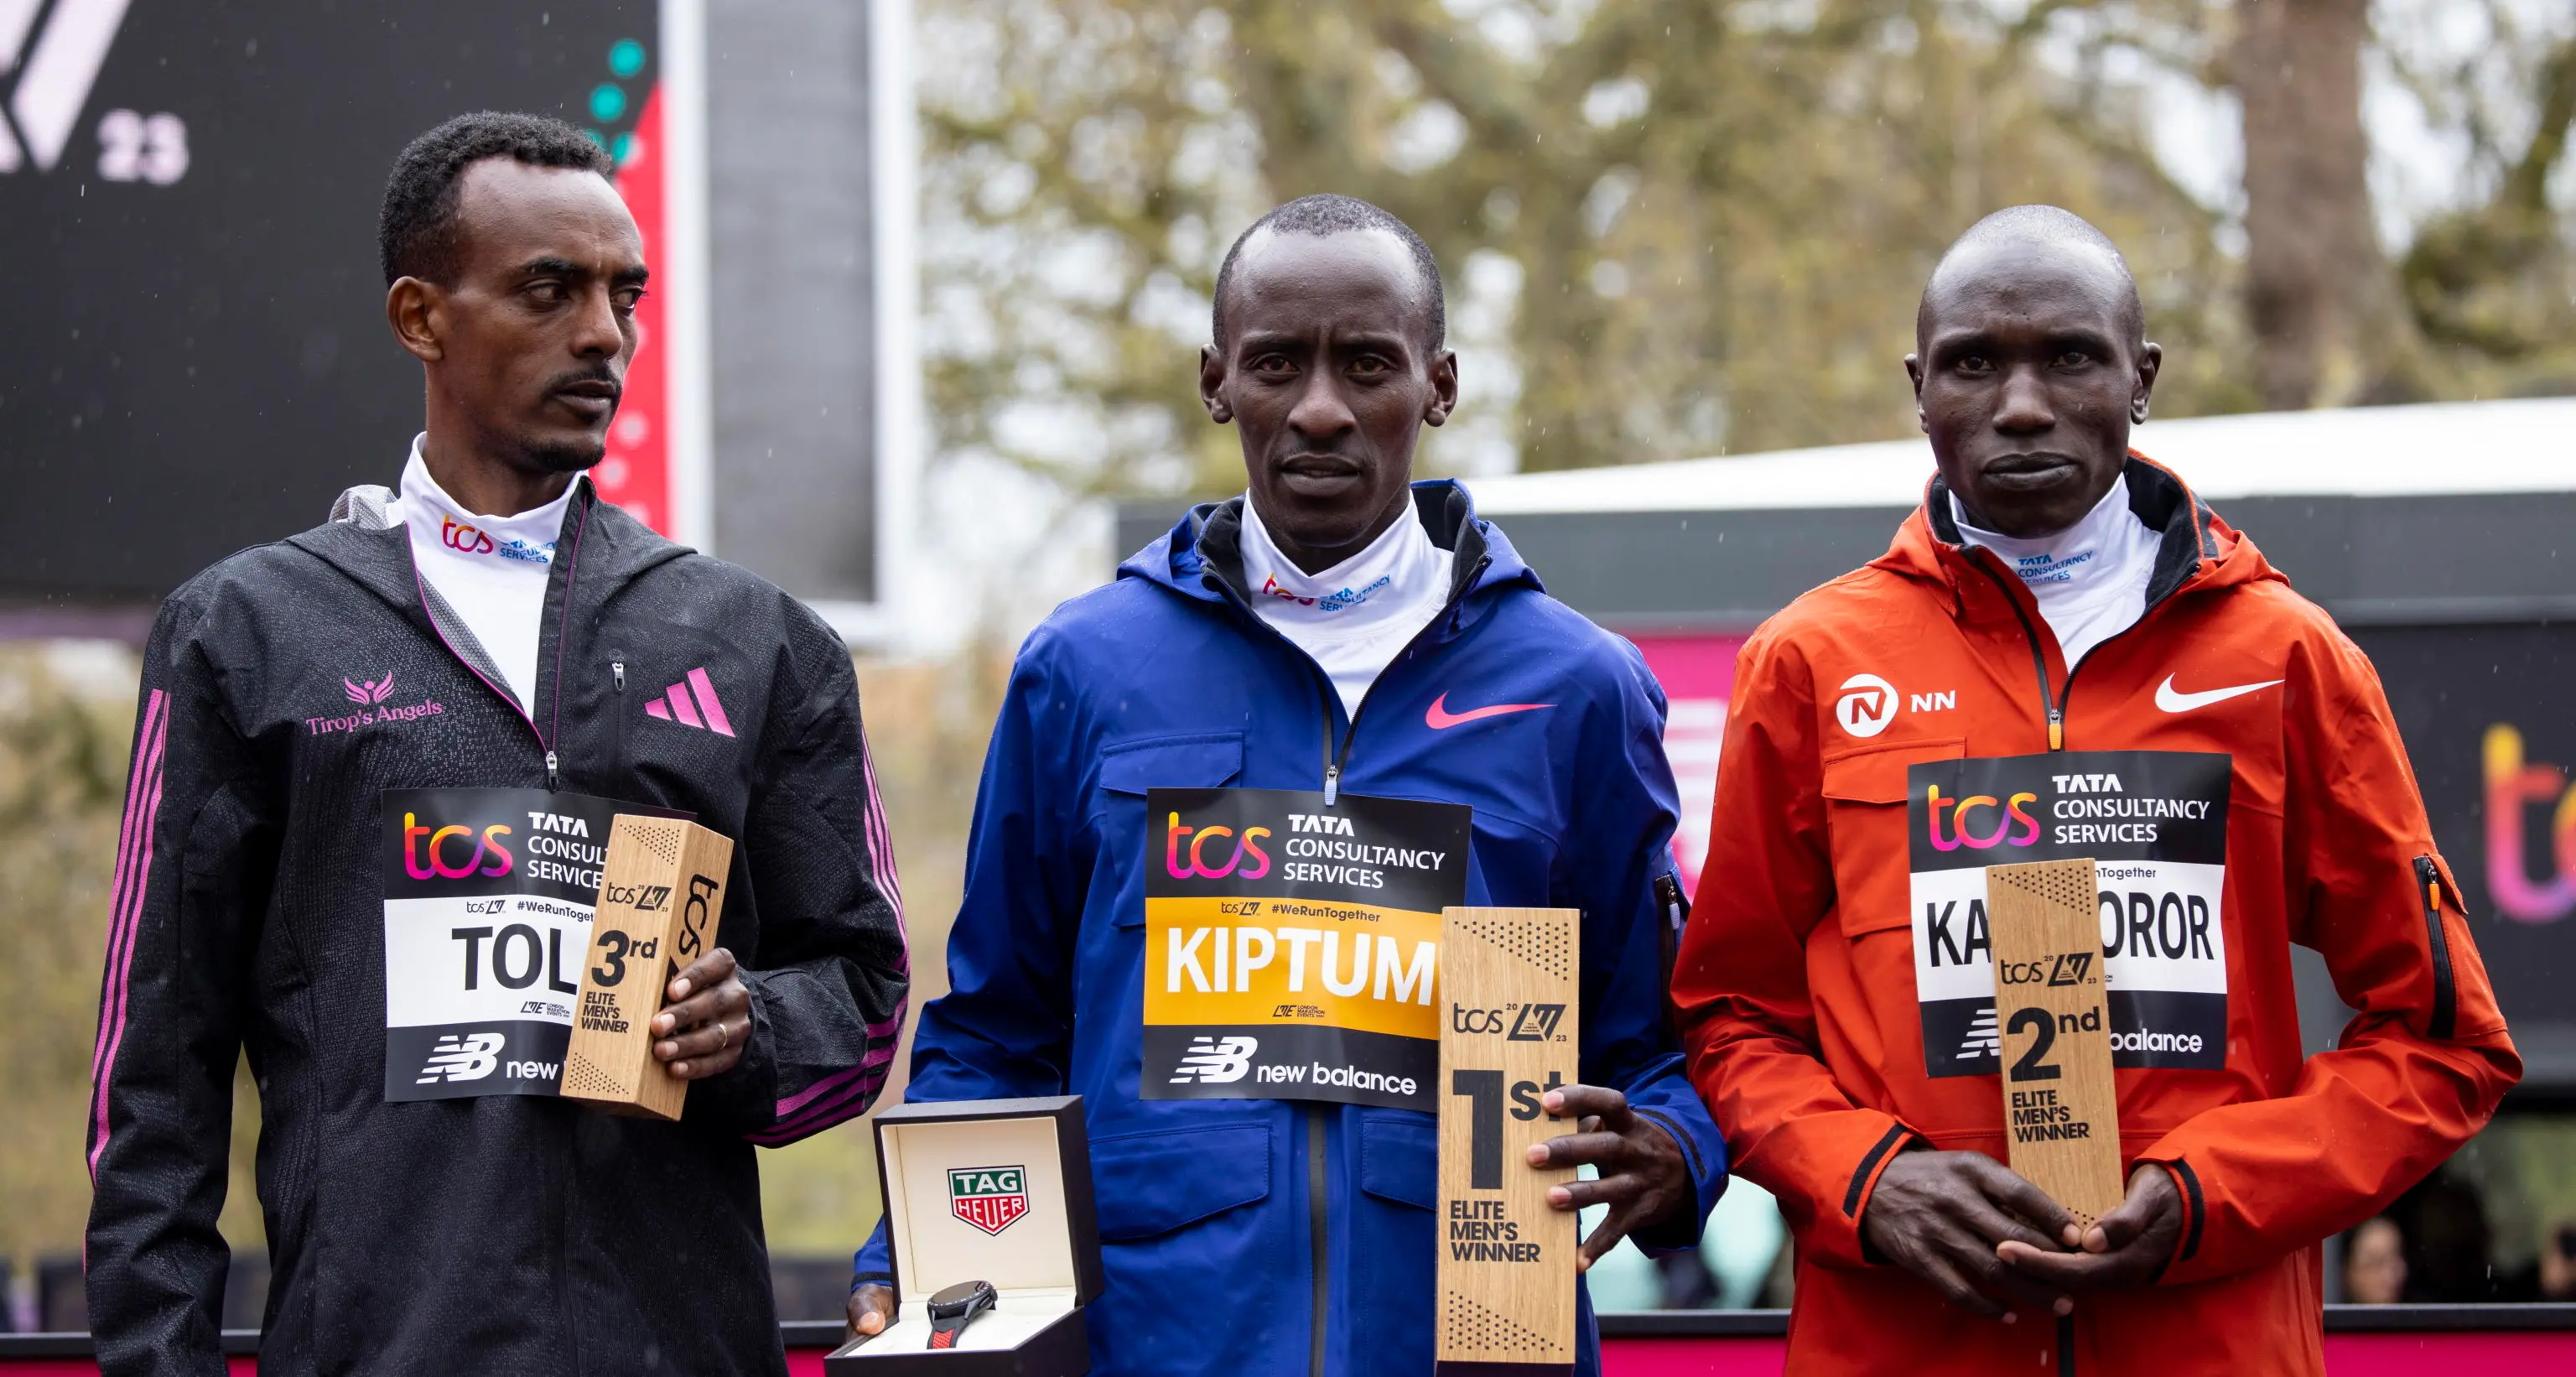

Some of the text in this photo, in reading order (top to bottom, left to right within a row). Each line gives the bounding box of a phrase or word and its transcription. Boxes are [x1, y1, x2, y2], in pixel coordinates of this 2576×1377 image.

[96, 108, 190, 186] 23
[443, 515, 493, 553] tcs
[2018, 553, 2052, 566] TATA
[2018, 550, 2093, 578] CONSULTANCY
[1911, 690, 1955, 713] NN
[306, 699, 443, 735] Tirop's Angels
[2052, 773, 2122, 793] TATA
[1928, 784, 2040, 851] tcs
[2054, 799, 2210, 820] CONSULTANCY
[527, 812, 589, 838] TATA
[1288, 814, 1354, 837] TATA
[2054, 824, 2158, 844] SERVICES
[404, 812, 513, 881] tcs
[527, 835, 607, 865] CONSUL
[1166, 811, 1271, 880] tcs
[1285, 838, 1446, 870] CONSULTANCY
[527, 860, 603, 889] SERVICE
[1284, 862, 1384, 889] SERVICES
[2096, 867, 2156, 880] nTogether
[606, 882, 636, 904] tcs
[517, 901, 594, 922] #WeRunToget
[678, 873, 719, 959] tcs
[1272, 904, 1381, 922] #WeRunTogether
[451, 923, 578, 995] TOL
[591, 930, 657, 987] 3rd
[1166, 927, 1436, 1006] KIPTUM
[2000, 959, 2044, 985] tcs
[585, 991, 615, 1005] ELITE
[583, 1005, 621, 1019] MEN'S
[1453, 1002, 1504, 1034] tcs
[581, 1017, 629, 1033] WINNER
[2007, 1006, 2101, 1082] 2nd
[506, 1061, 559, 1080] new
[1257, 1062, 1417, 1095] new balance
[2012, 1089, 2058, 1108] ELITE
[2013, 1105, 2071, 1125] MEN'S
[2014, 1122, 2090, 1142] WINNER
[956, 1172, 1018, 1193] TAG
[958, 1198, 1022, 1229] HEUER
[1450, 1201, 1504, 1220] ELITE
[1450, 1221, 1519, 1241] MEN'S
[1451, 1243, 1541, 1263] WINNER
